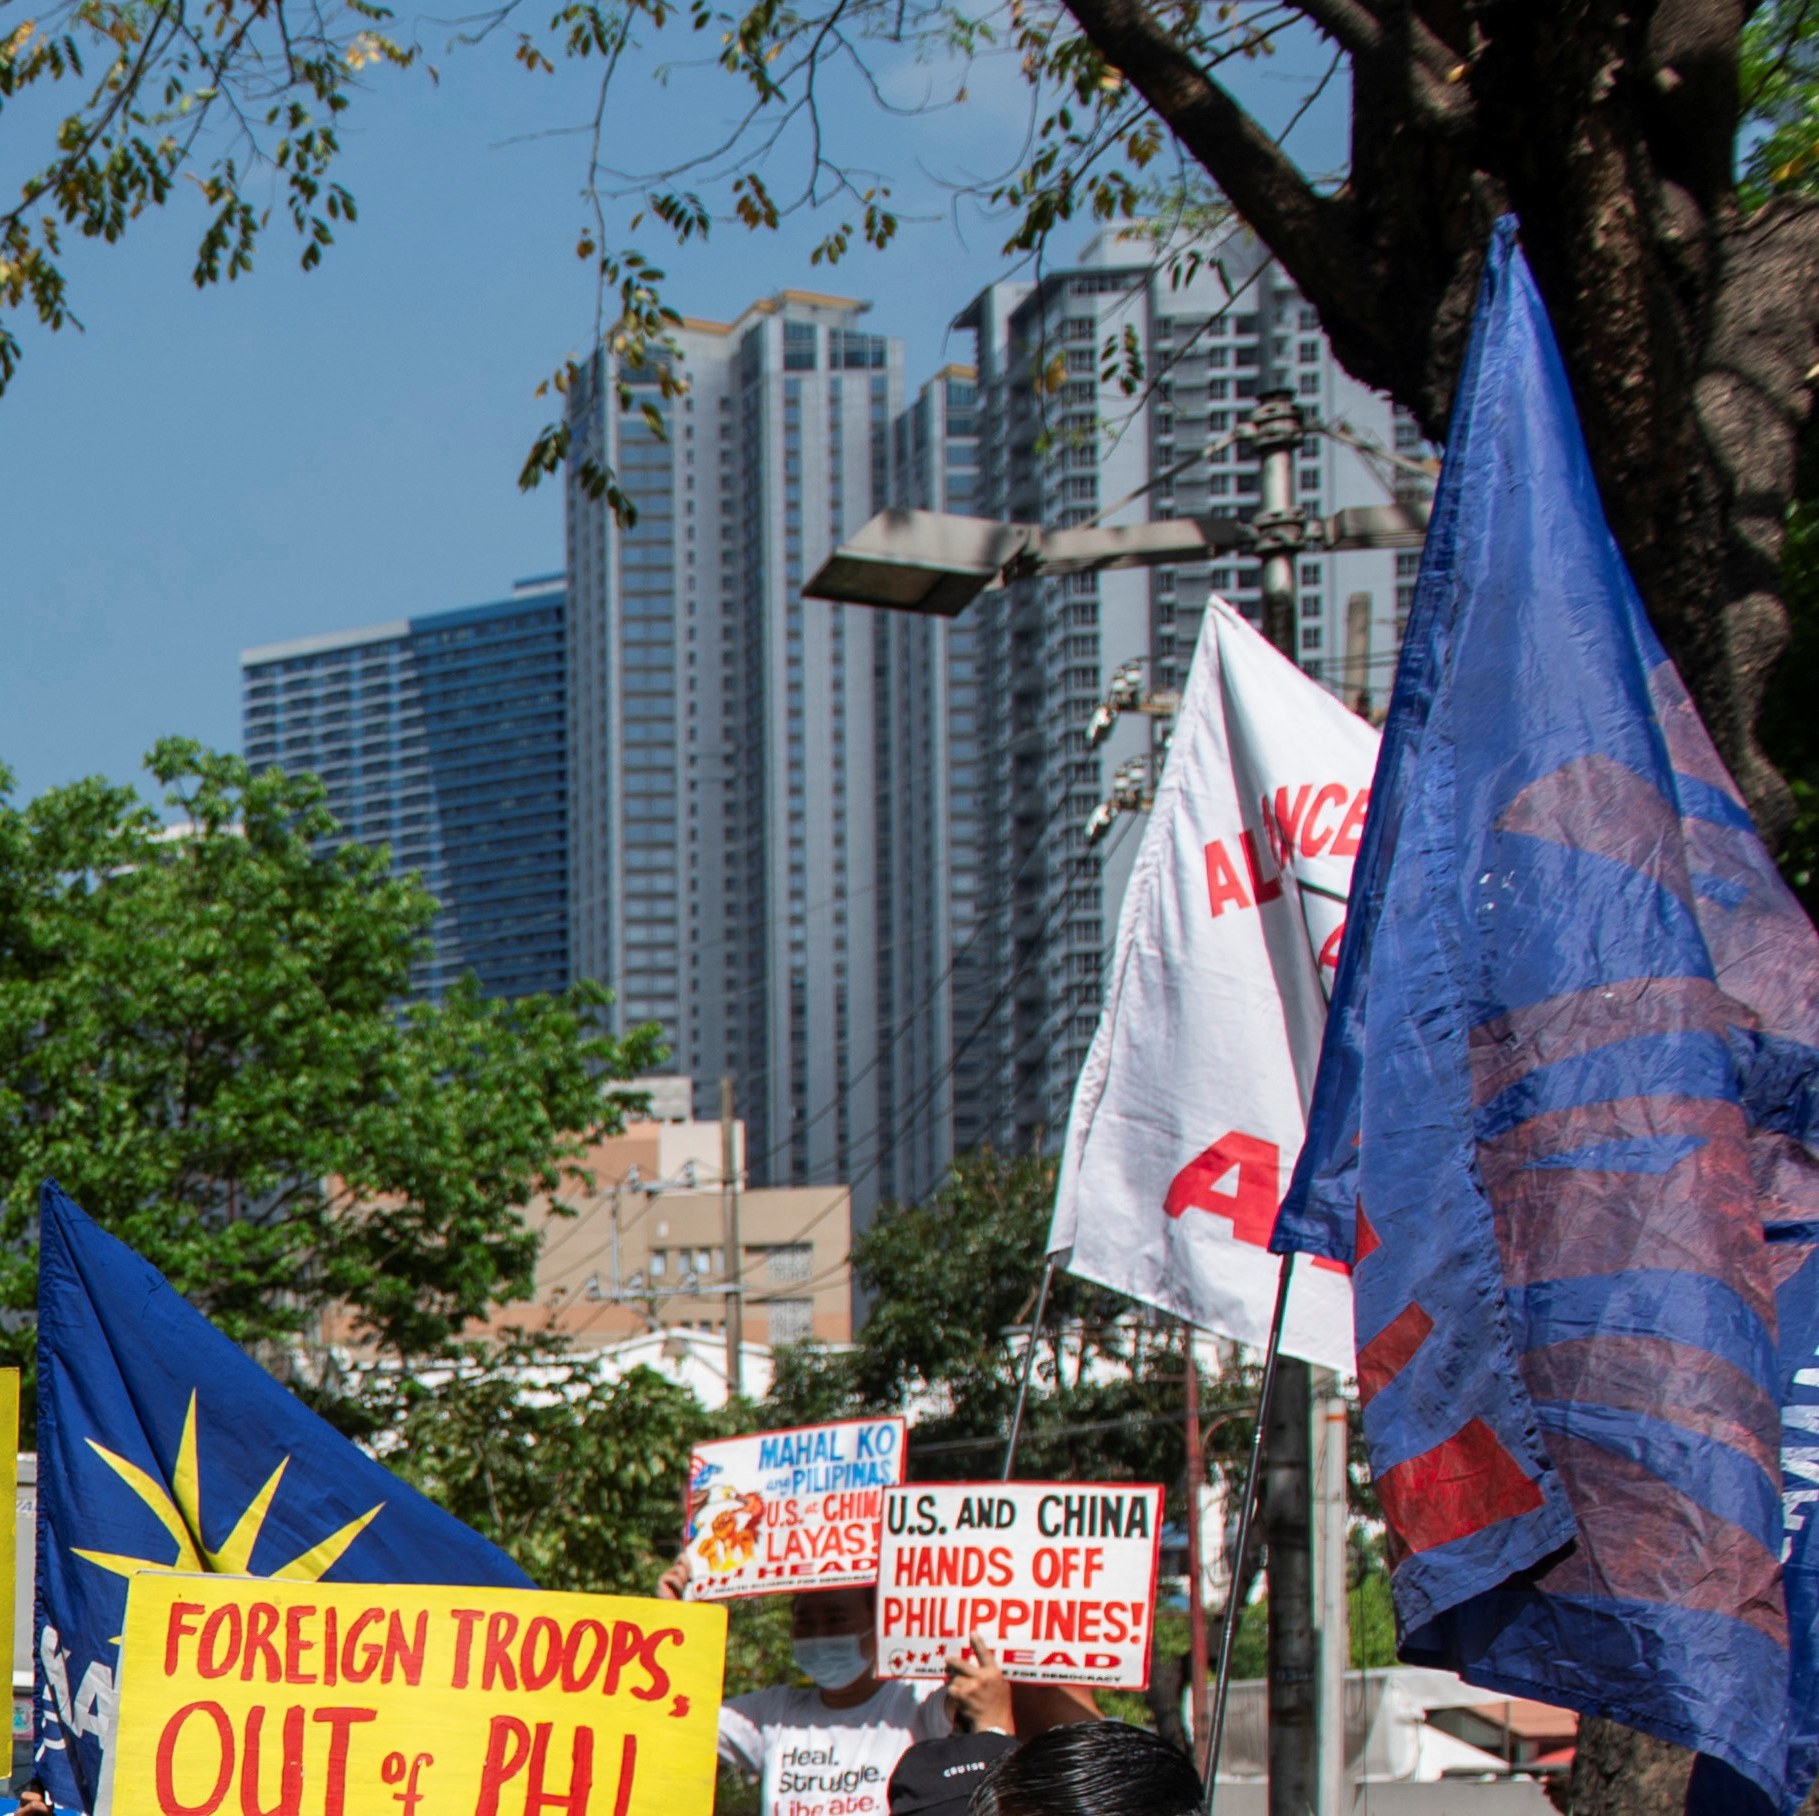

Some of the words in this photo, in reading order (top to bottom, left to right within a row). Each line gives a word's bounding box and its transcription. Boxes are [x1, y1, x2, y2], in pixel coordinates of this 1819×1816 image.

[759, 1430, 845, 1472] MAHAL
[857, 1423, 896, 1458] KO
[765, 1477, 792, 1496] ang
[766, 1499, 804, 1528] U.S.
[822, 1490, 882, 1523] CHIN
[887, 1494, 948, 1536] U.S.
[956, 1497, 1018, 1530] AND
[1037, 1494, 1150, 1539] CHINA
[766, 1522, 880, 1563] LAYAS!
[894, 1546, 1015, 1588] HANDS
[1032, 1546, 1105, 1589] OFF
[882, 1596, 1145, 1646] PHILIPPINES!
[164, 1602, 429, 1687] FOREIGN
[450, 1606, 692, 1719] TROOPS,
[781, 1746, 840, 1769] Heal.
